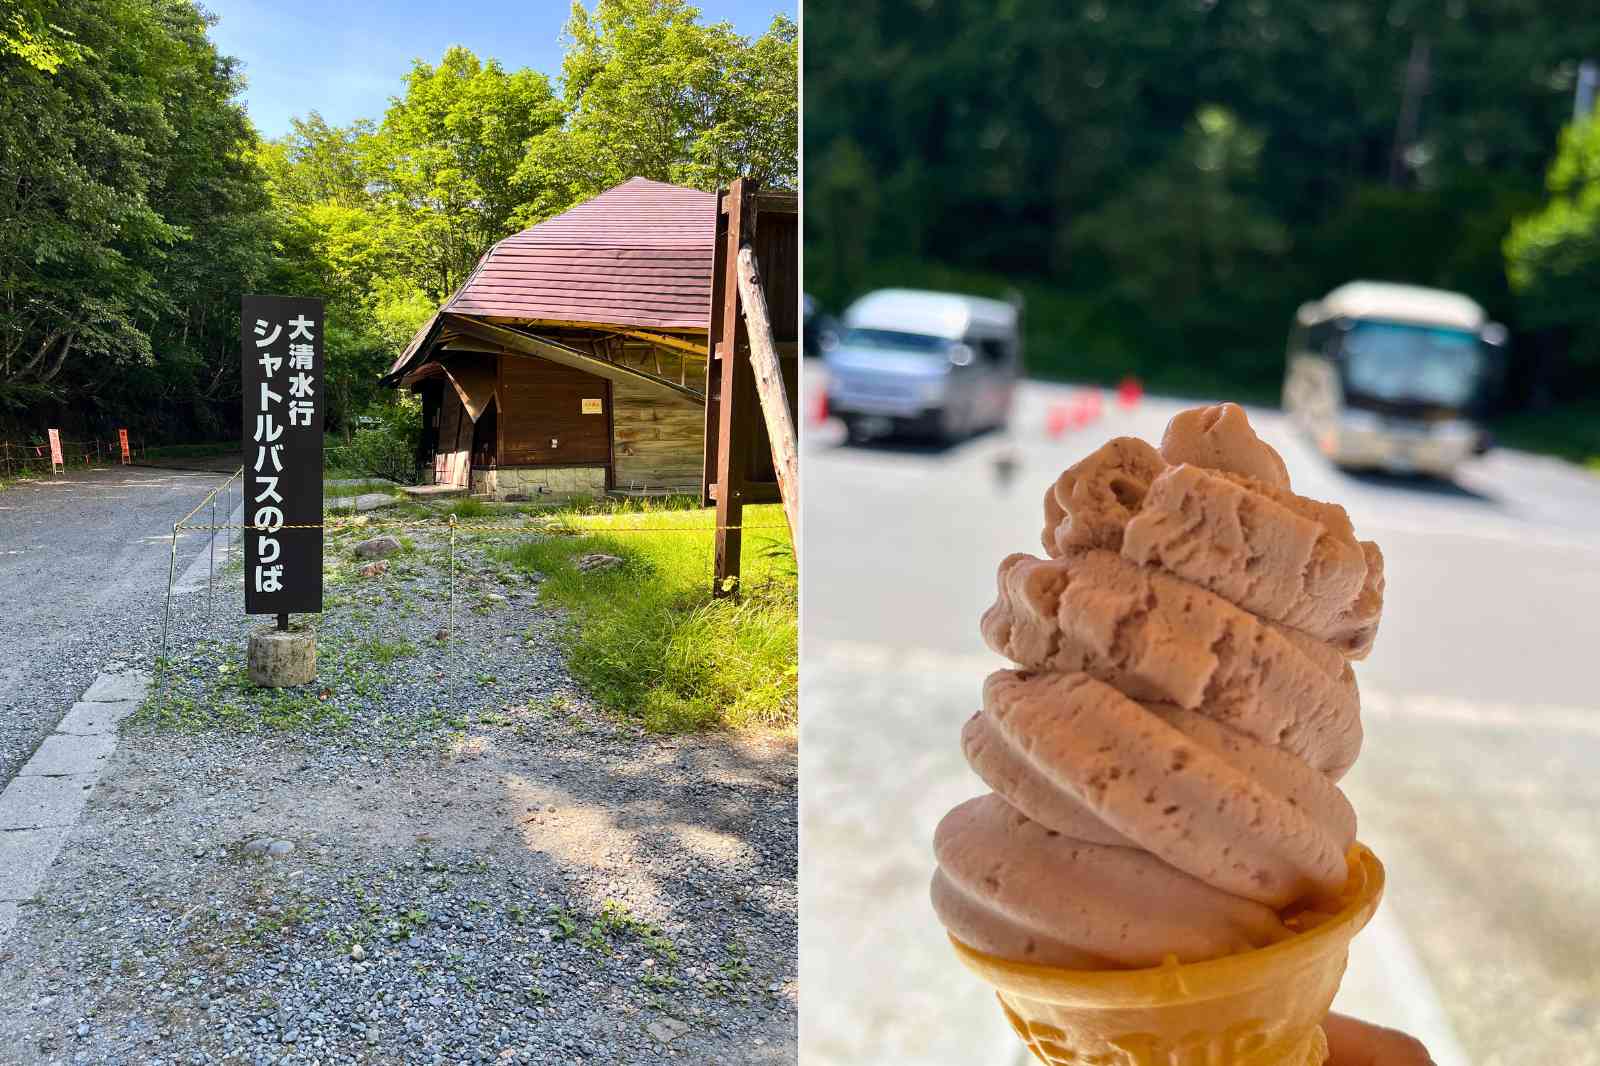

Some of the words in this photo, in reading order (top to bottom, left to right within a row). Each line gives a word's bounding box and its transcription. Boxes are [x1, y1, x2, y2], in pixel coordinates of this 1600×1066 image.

[253, 319, 284, 592] シャトルバスのりば
[288, 314, 315, 426] 大清水行
